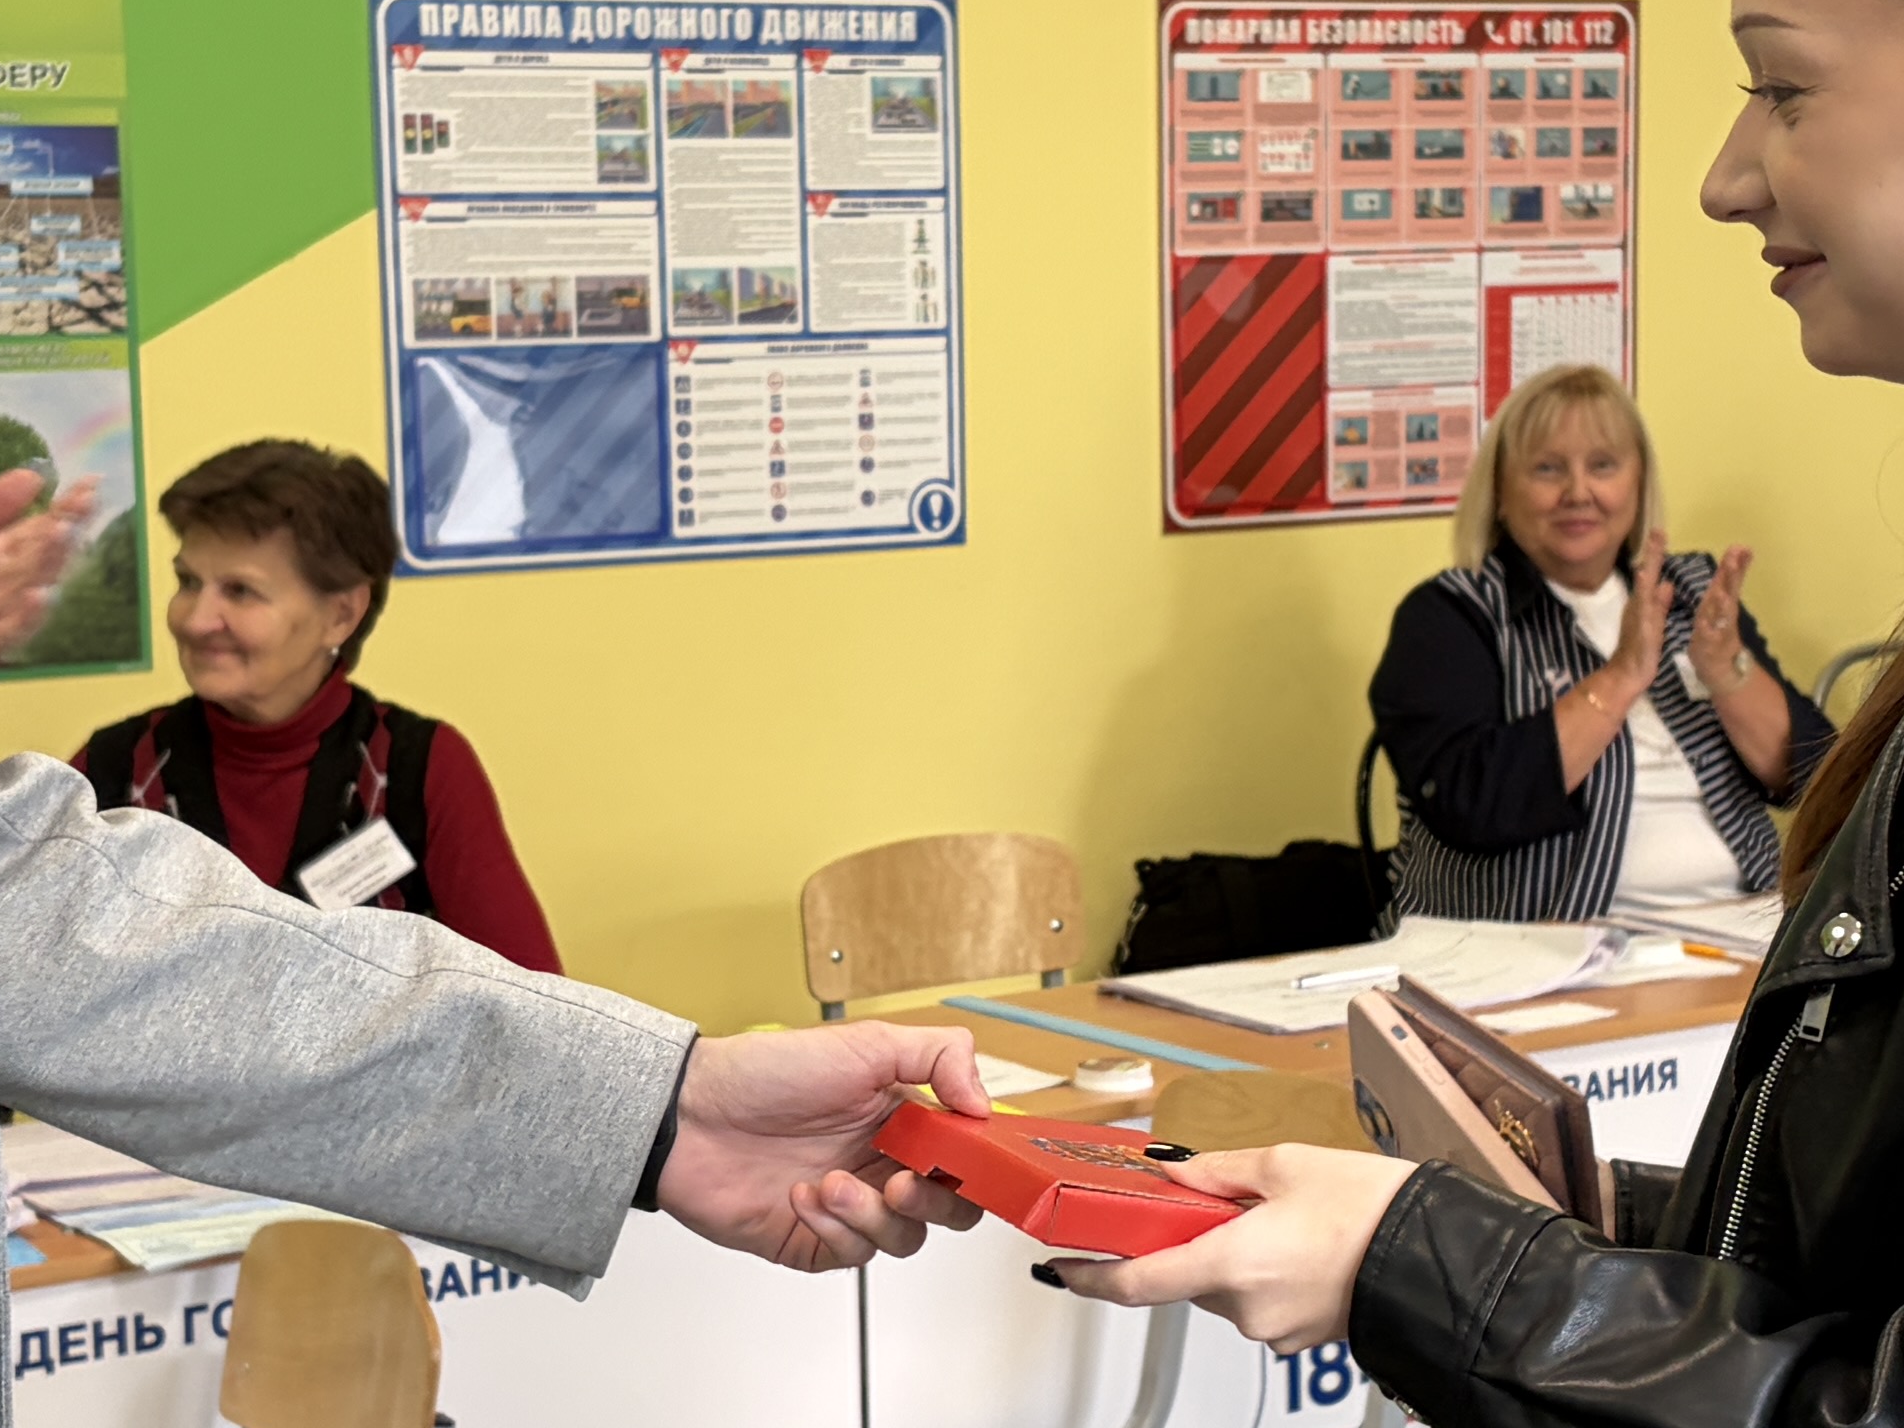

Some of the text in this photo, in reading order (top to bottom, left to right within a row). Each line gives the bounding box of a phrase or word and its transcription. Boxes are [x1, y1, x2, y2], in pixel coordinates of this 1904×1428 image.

[419, 3, 918, 45] ПРАВИЛА ДОРОЖНОГО ДВИЖЕНИЯ
[1185, 18, 1299, 45] ПОЖАРНАЯ
[1306, 18, 1466, 46] БЕЗОПАСНОСТЬ
[1582, 19, 1616, 45] 112
[14, 1314, 166, 1380] ДЕНЬ
